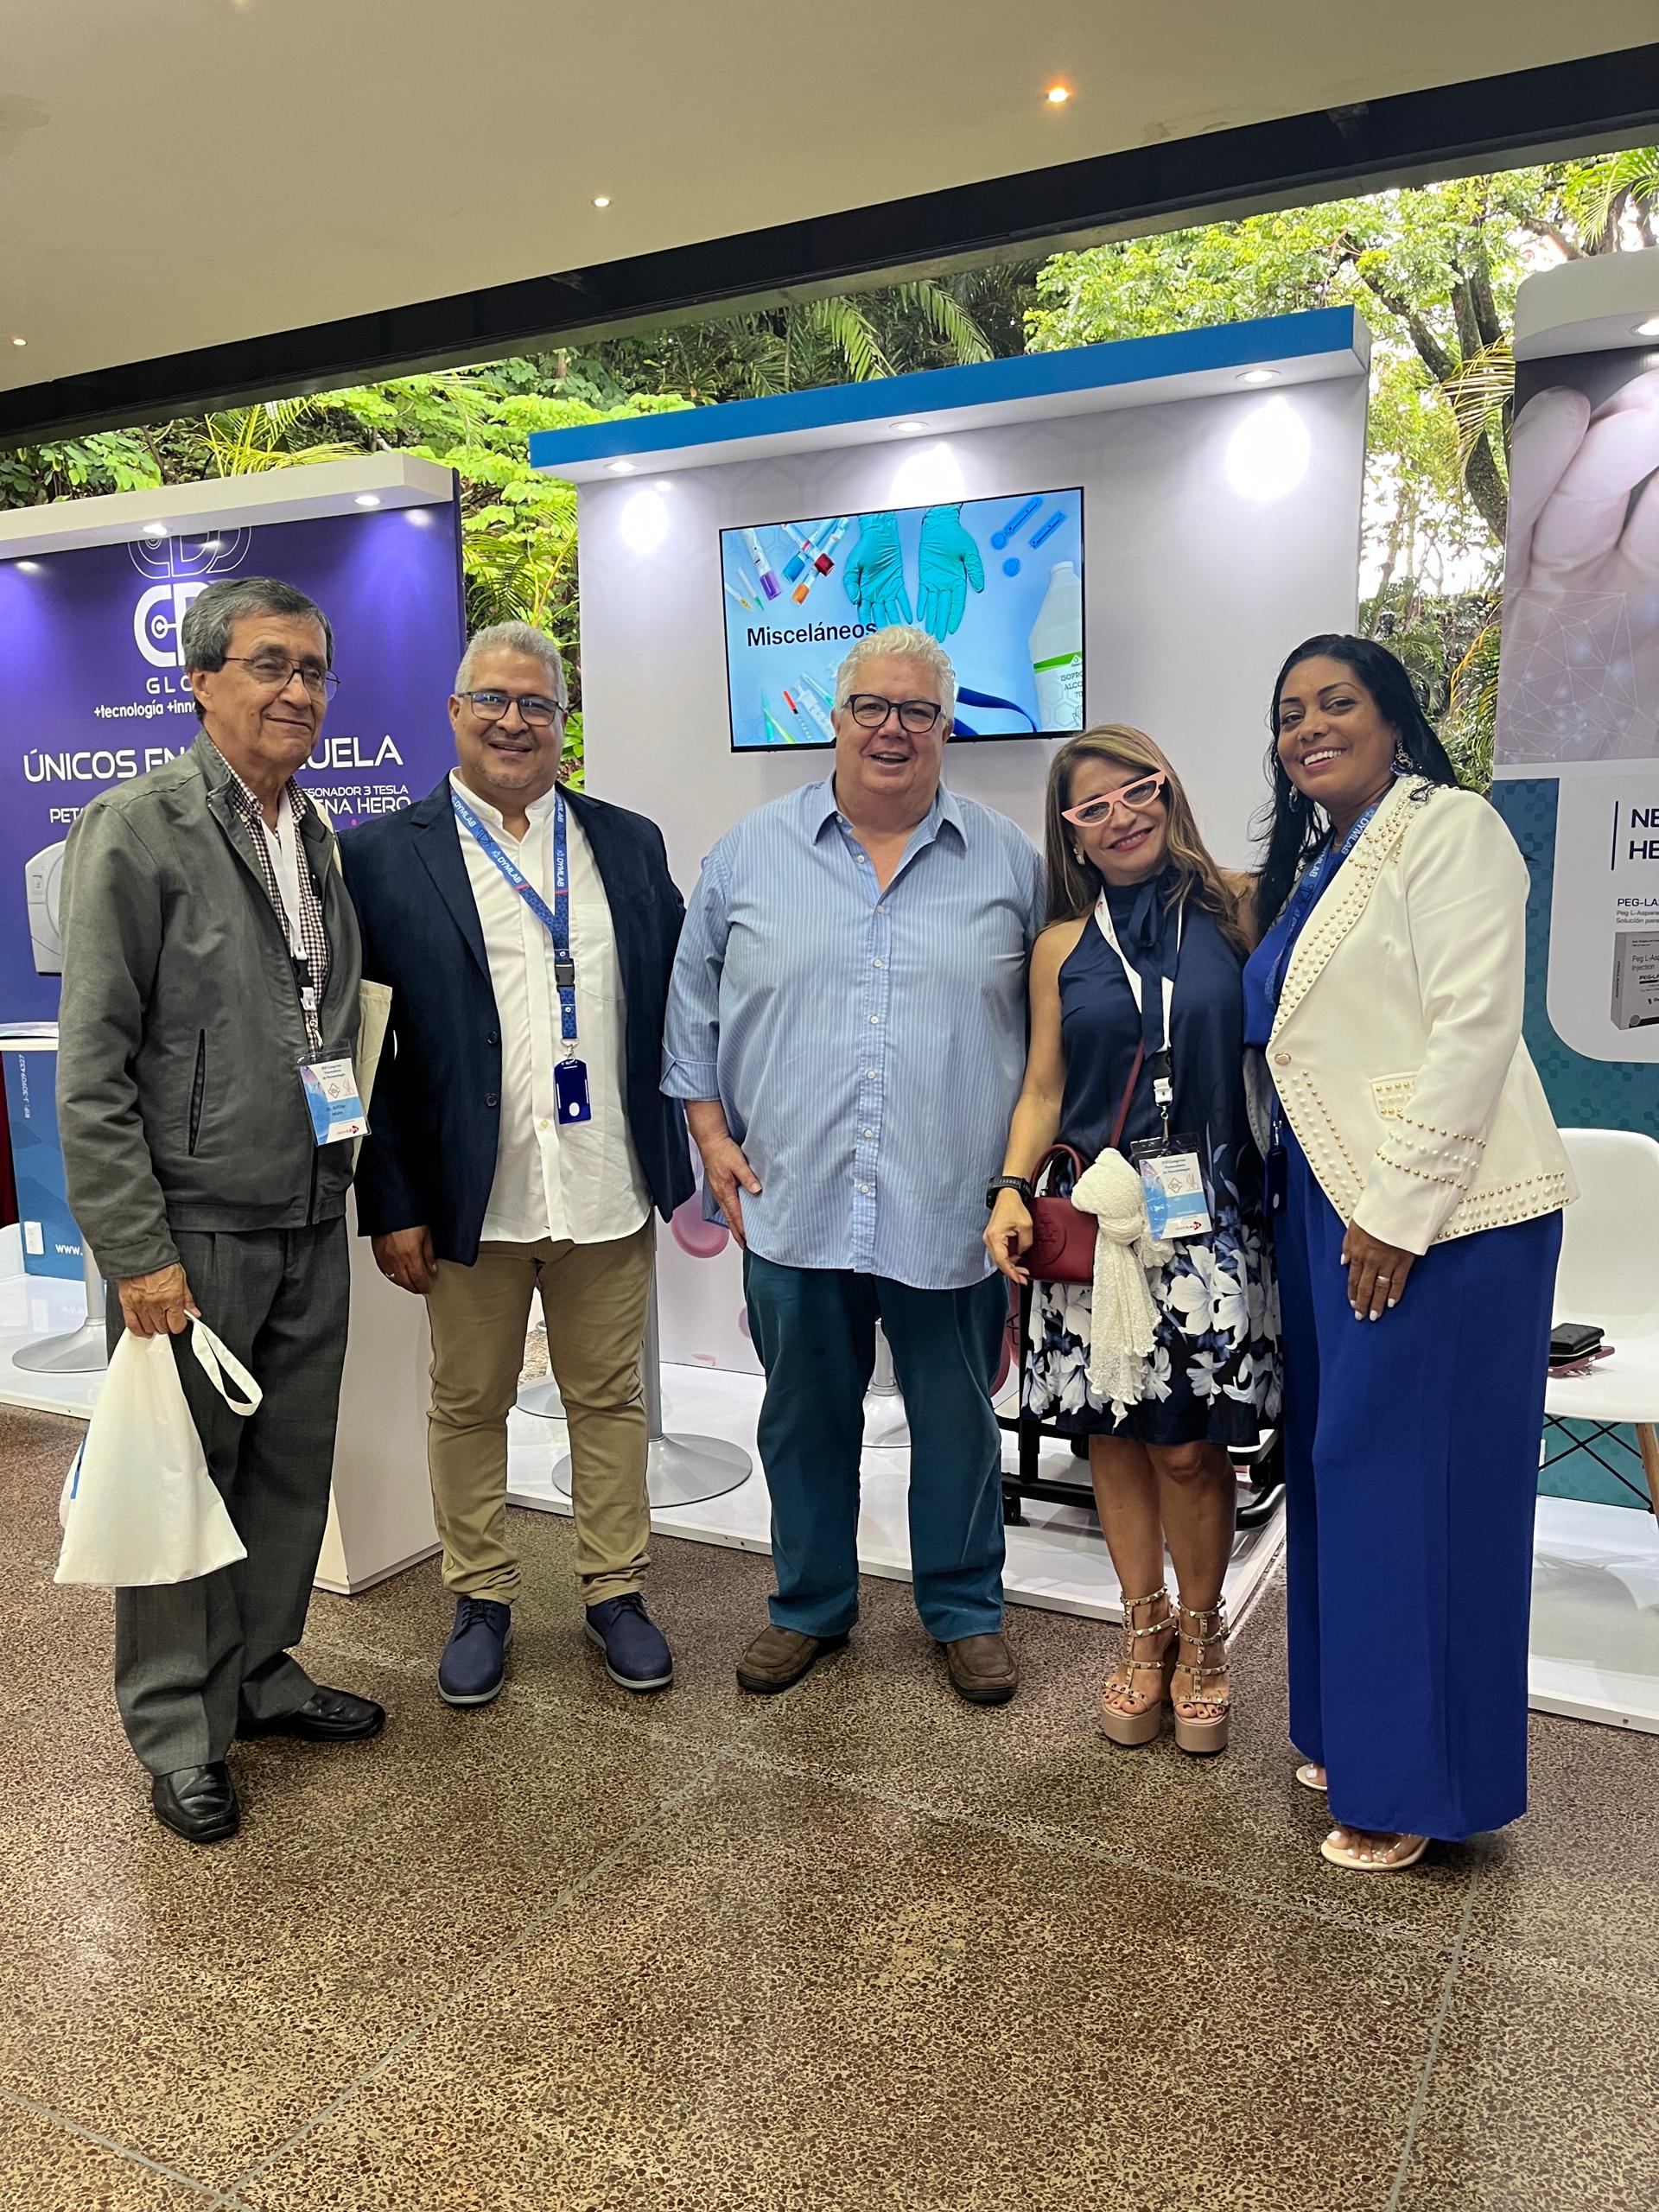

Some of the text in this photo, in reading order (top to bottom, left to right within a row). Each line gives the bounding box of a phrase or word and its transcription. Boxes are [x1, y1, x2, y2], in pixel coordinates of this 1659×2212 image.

[747, 622, 877, 646] Misceláneos
[94, 699, 163, 719] +tecnología
[299, 734, 404, 770] UELA
[23, 748, 137, 782] ÚNICOS
[364, 786, 371, 795] 3
[372, 785, 409, 795] TESLA
[316, 797, 411, 814] NA HERO
[454, 800, 476, 827] DYMLAB
[1631, 808, 1659, 828] NE
[1341, 817, 1369, 855] DYMLAB
[1629, 840, 1659, 860] HE
[497, 856, 522, 883] DYMLAB
[556, 858, 565, 887] DYMLAB
[1618, 898, 1659, 906] PEG-LA
[55, 1243, 84, 1256] www.
